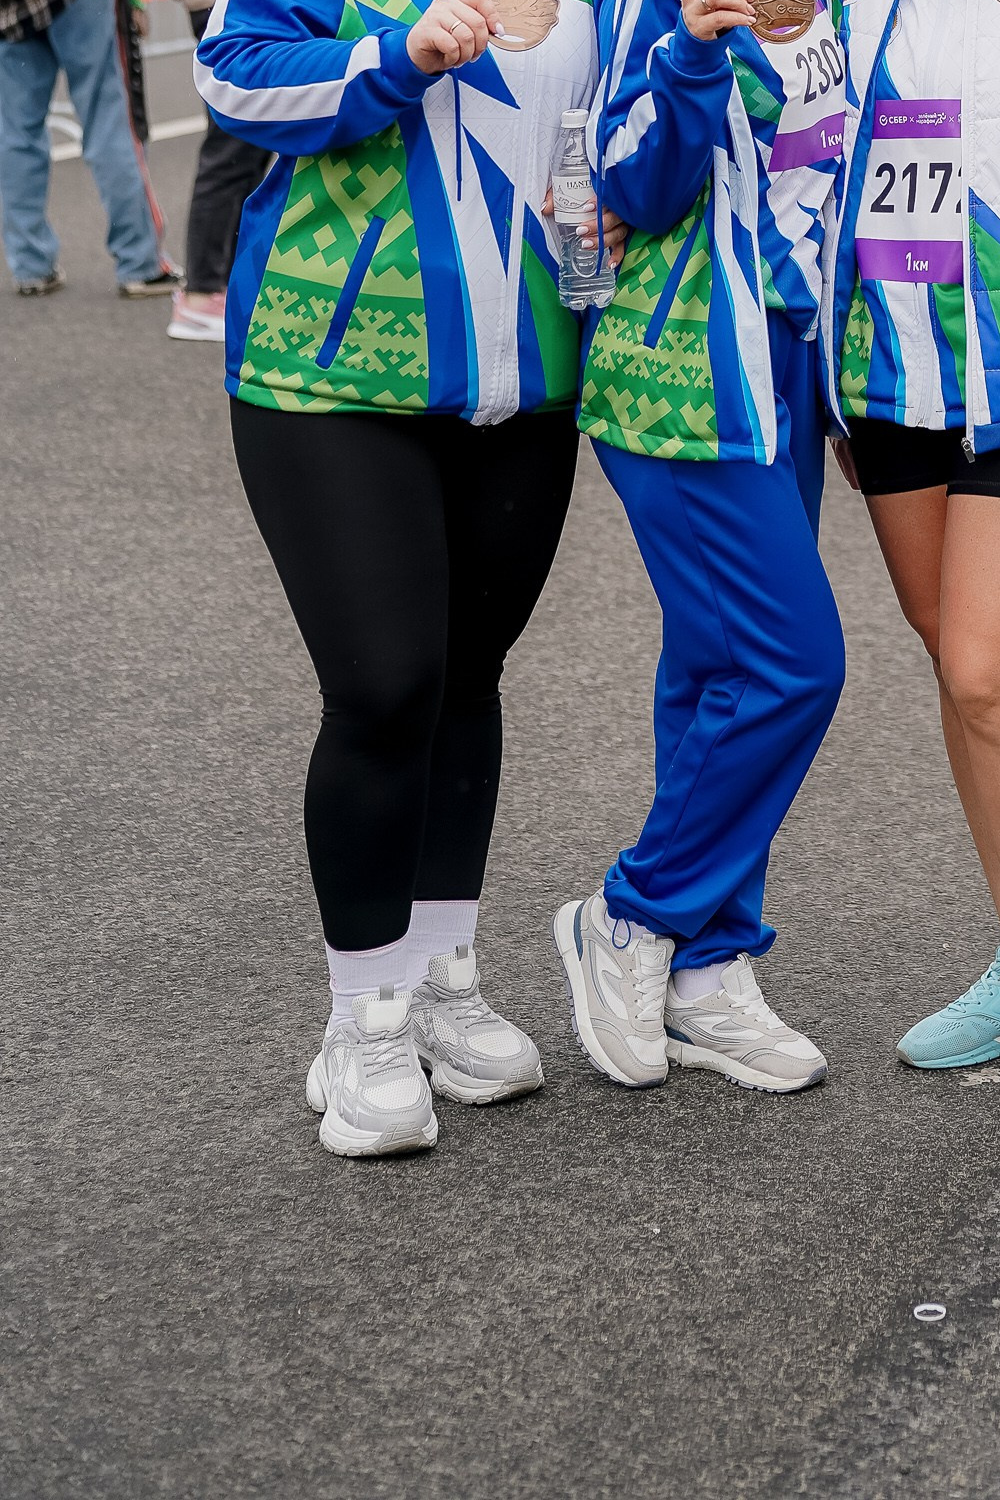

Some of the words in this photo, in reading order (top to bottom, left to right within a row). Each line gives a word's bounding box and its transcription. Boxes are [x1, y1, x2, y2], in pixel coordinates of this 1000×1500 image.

[795, 31, 844, 105] 230
[888, 115, 908, 124] СБЕР
[870, 162, 962, 214] 217
